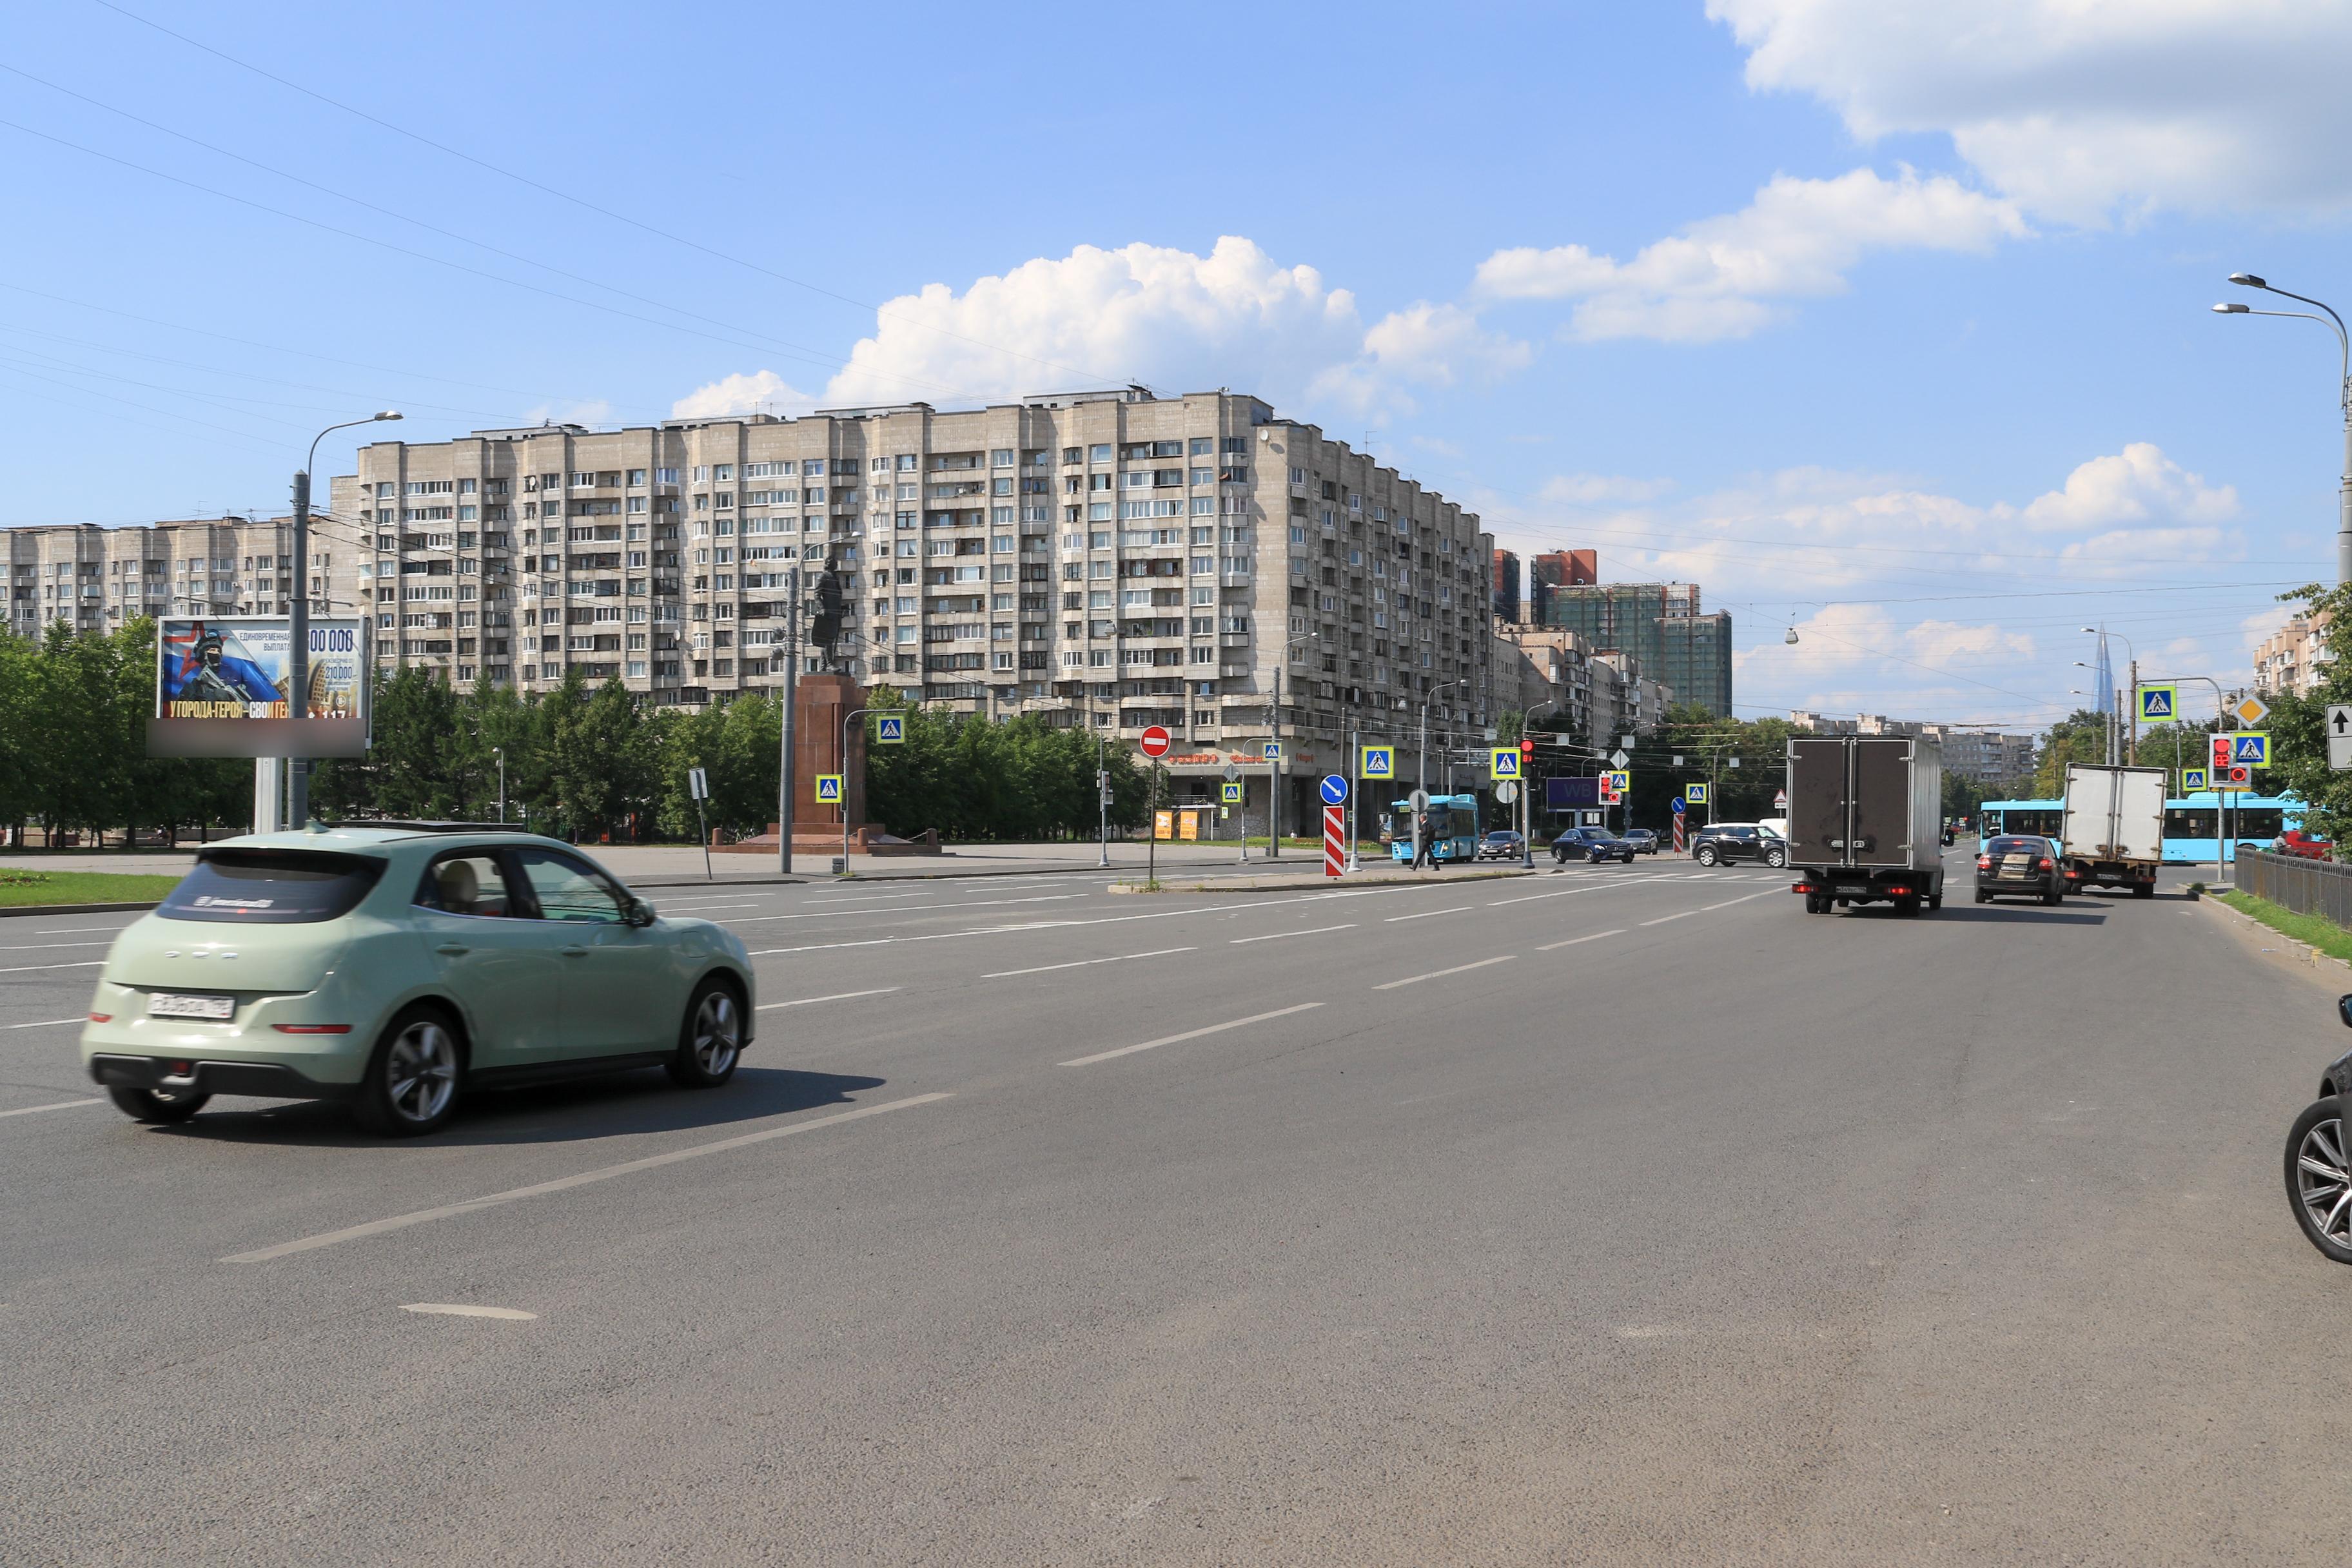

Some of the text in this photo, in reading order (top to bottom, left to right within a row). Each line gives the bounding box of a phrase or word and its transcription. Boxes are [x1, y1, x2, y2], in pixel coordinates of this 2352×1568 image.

[309, 629, 353, 652] 00 000
[326, 666, 352, 679] 210 000
[170, 701, 176, 718] У
[177, 701, 243, 718] ГОРОДА-ГЕРОЯ
[249, 701, 274, 718] СВОИ
[1563, 783, 1591, 798] WB
